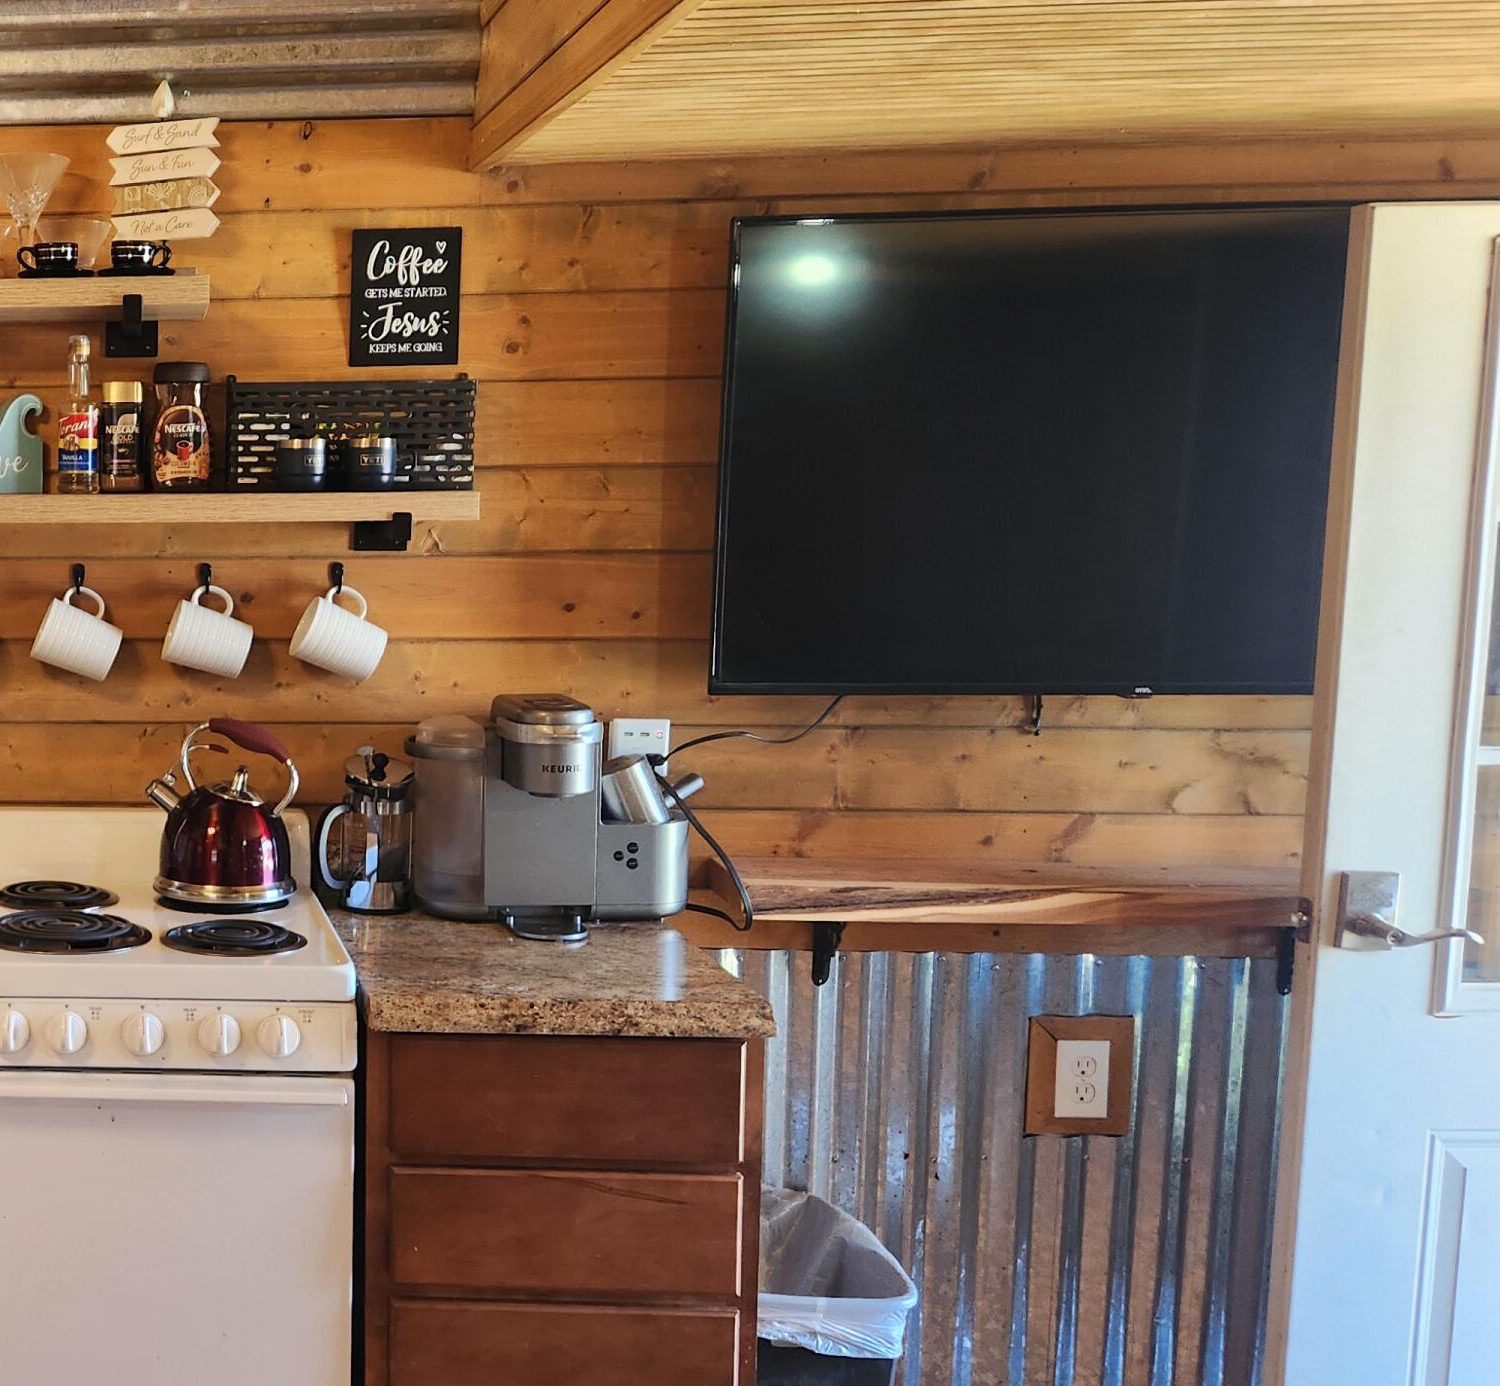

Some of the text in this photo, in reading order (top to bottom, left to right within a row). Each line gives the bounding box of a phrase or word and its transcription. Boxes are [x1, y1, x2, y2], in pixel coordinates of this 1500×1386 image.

[122, 122, 203, 150] Surf & Sand
[130, 154, 194, 180] Sun & Fun
[130, 220, 154, 236] Not
[165, 215, 194, 233] Care
[366, 240, 449, 286] Coffee
[364, 288, 388, 298] GETS
[389, 288, 404, 298] ME
[368, 302, 442, 341] Jesus
[369, 343, 397, 354] KEEPS
[398, 343, 412, 353] ME
